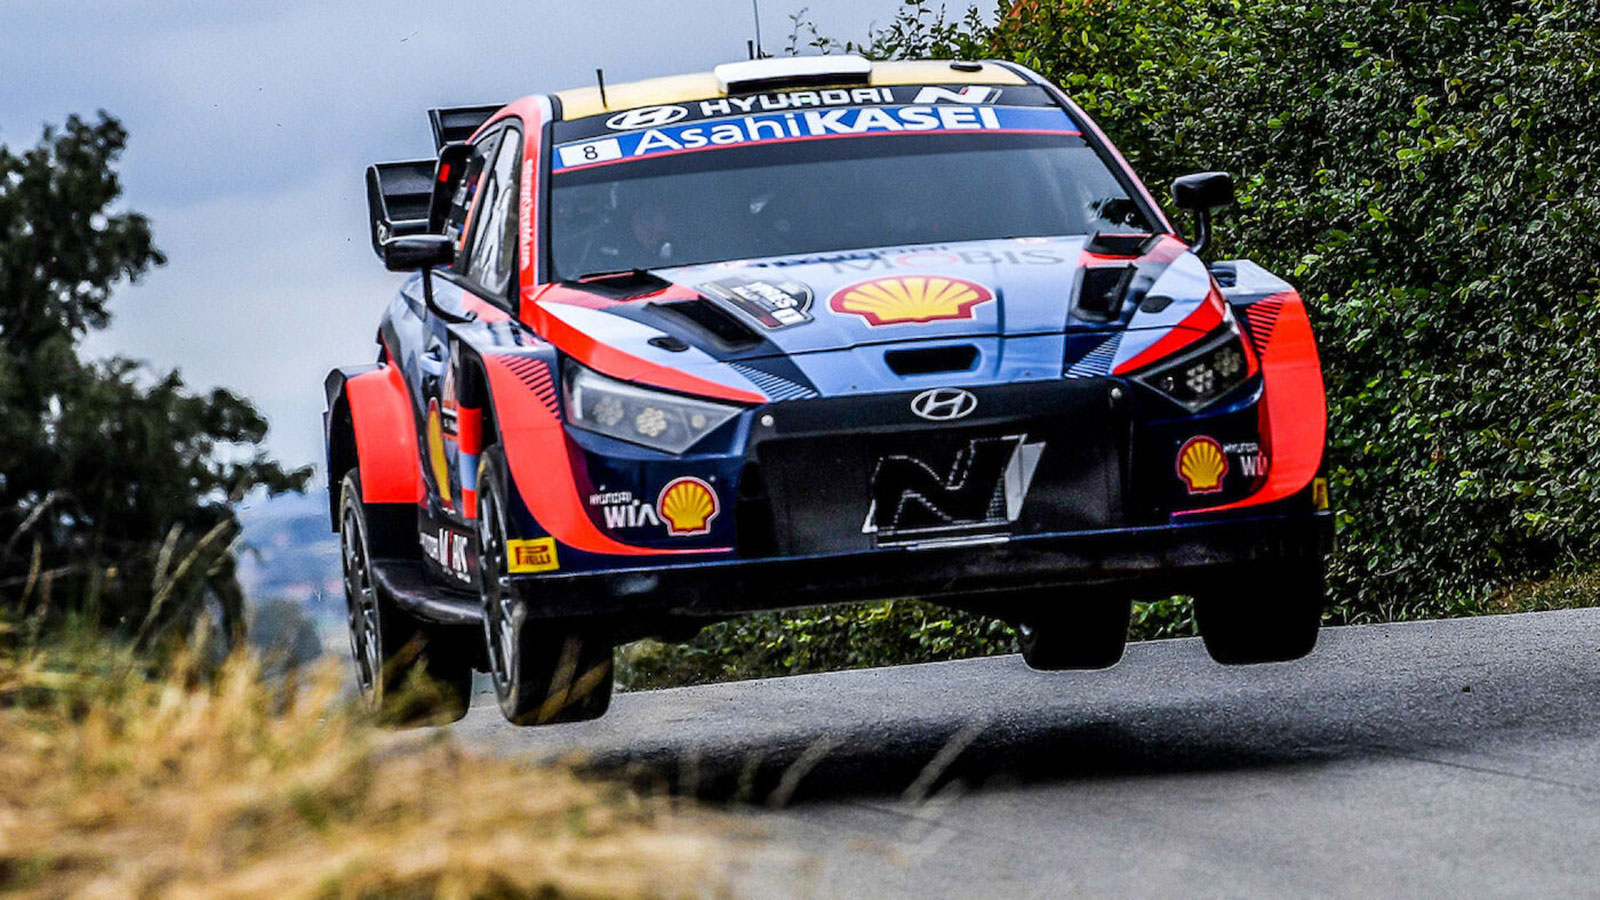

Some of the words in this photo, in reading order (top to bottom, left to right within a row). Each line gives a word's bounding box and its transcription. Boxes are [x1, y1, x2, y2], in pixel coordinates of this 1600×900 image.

[700, 87, 895, 117] HYUNDAI
[583, 145, 598, 160] 8
[828, 248, 1064, 273] MOBIS
